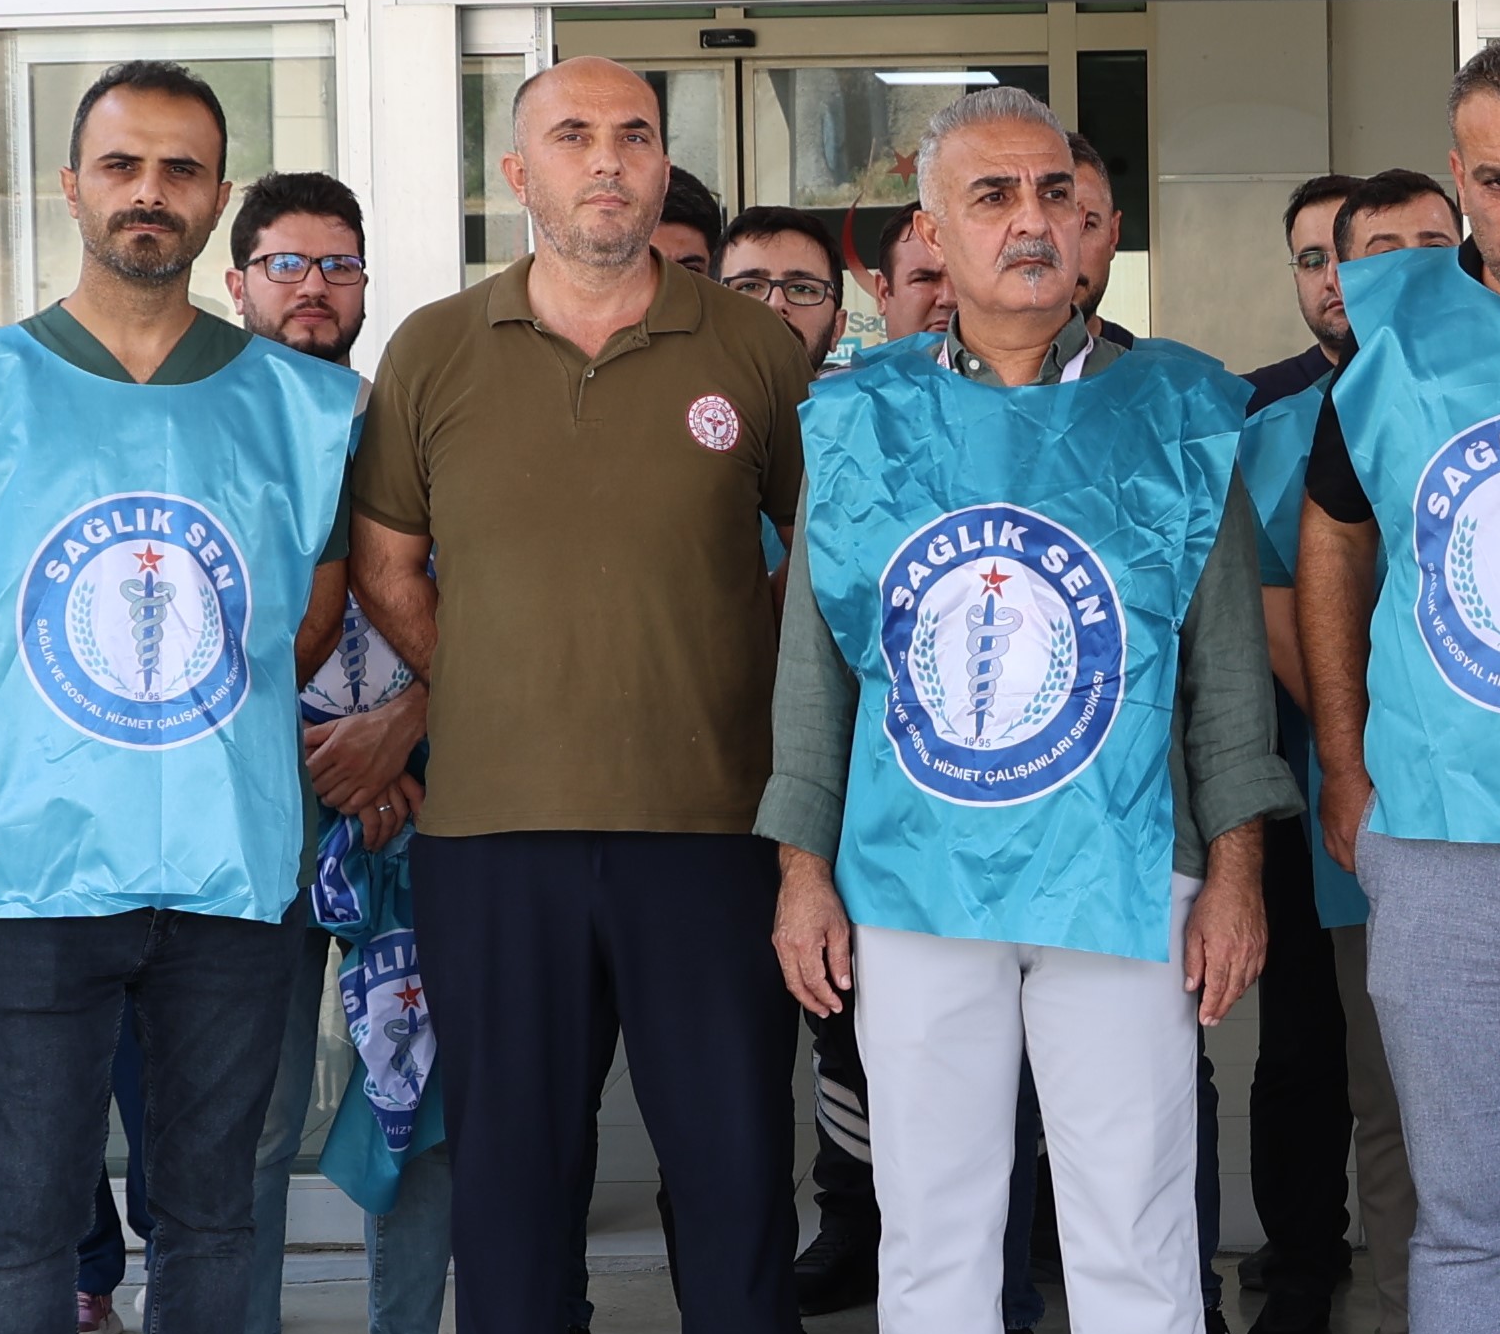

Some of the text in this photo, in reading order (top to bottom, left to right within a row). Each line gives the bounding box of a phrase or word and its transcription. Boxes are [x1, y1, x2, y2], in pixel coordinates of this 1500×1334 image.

[45, 508, 235, 590] SAĞLIK SEN
[891, 520, 1107, 627] SAĞLIK SEN
[37, 618, 56, 665] SAĞLIK
[51, 665, 65, 684] VE
[61, 679, 103, 718] SOSYAL
[105, 709, 153, 730] HİZMET
[156, 684, 229, 731] ÇALIŞANLARI
[1432, 617, 1447, 635] VE
[1442, 633, 1485, 680] SOSYAL
[894, 706, 909, 725] VE
[932, 758, 982, 783] HİZMET
[985, 737, 1073, 786] ÇALIŞANLARI
[1070, 670, 1106, 740] SENDİKASI
